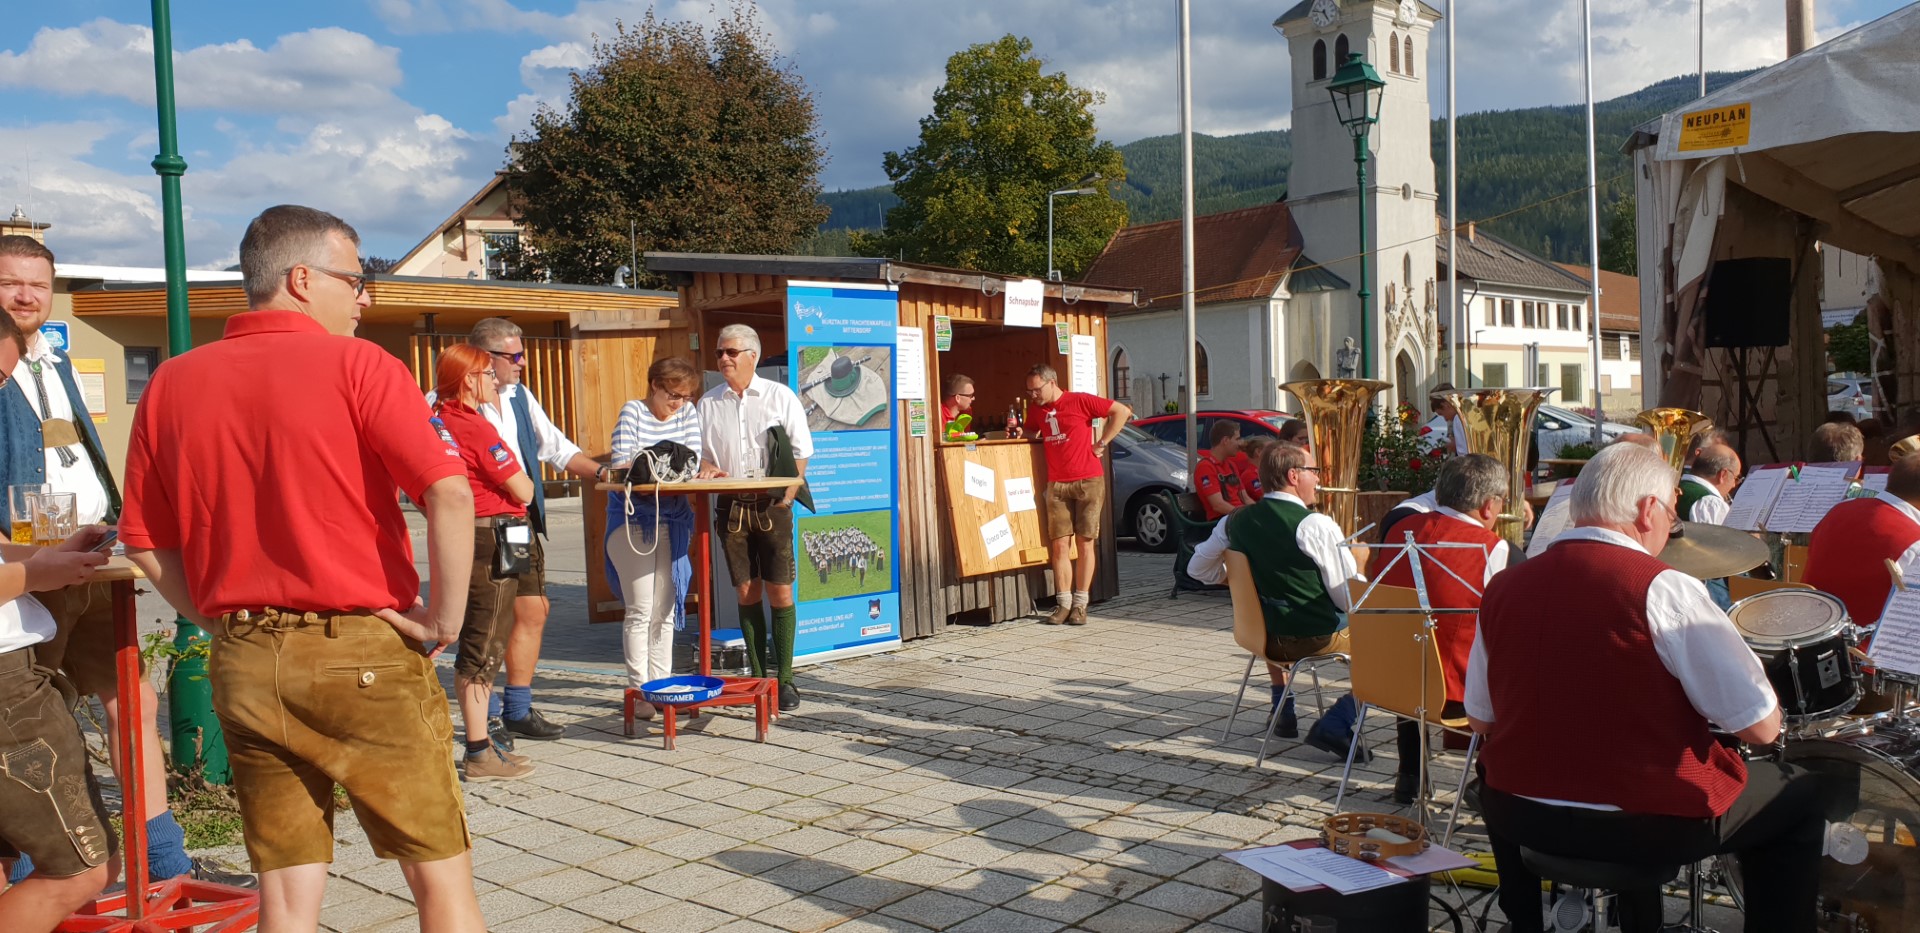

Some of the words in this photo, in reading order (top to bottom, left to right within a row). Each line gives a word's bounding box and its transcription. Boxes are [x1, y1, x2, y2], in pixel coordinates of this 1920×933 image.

[1686, 108, 1746, 128] NEUPLAN
[1009, 296, 1040, 307] Schnapsbar
[649, 693, 694, 702] PUNTIGAMER
